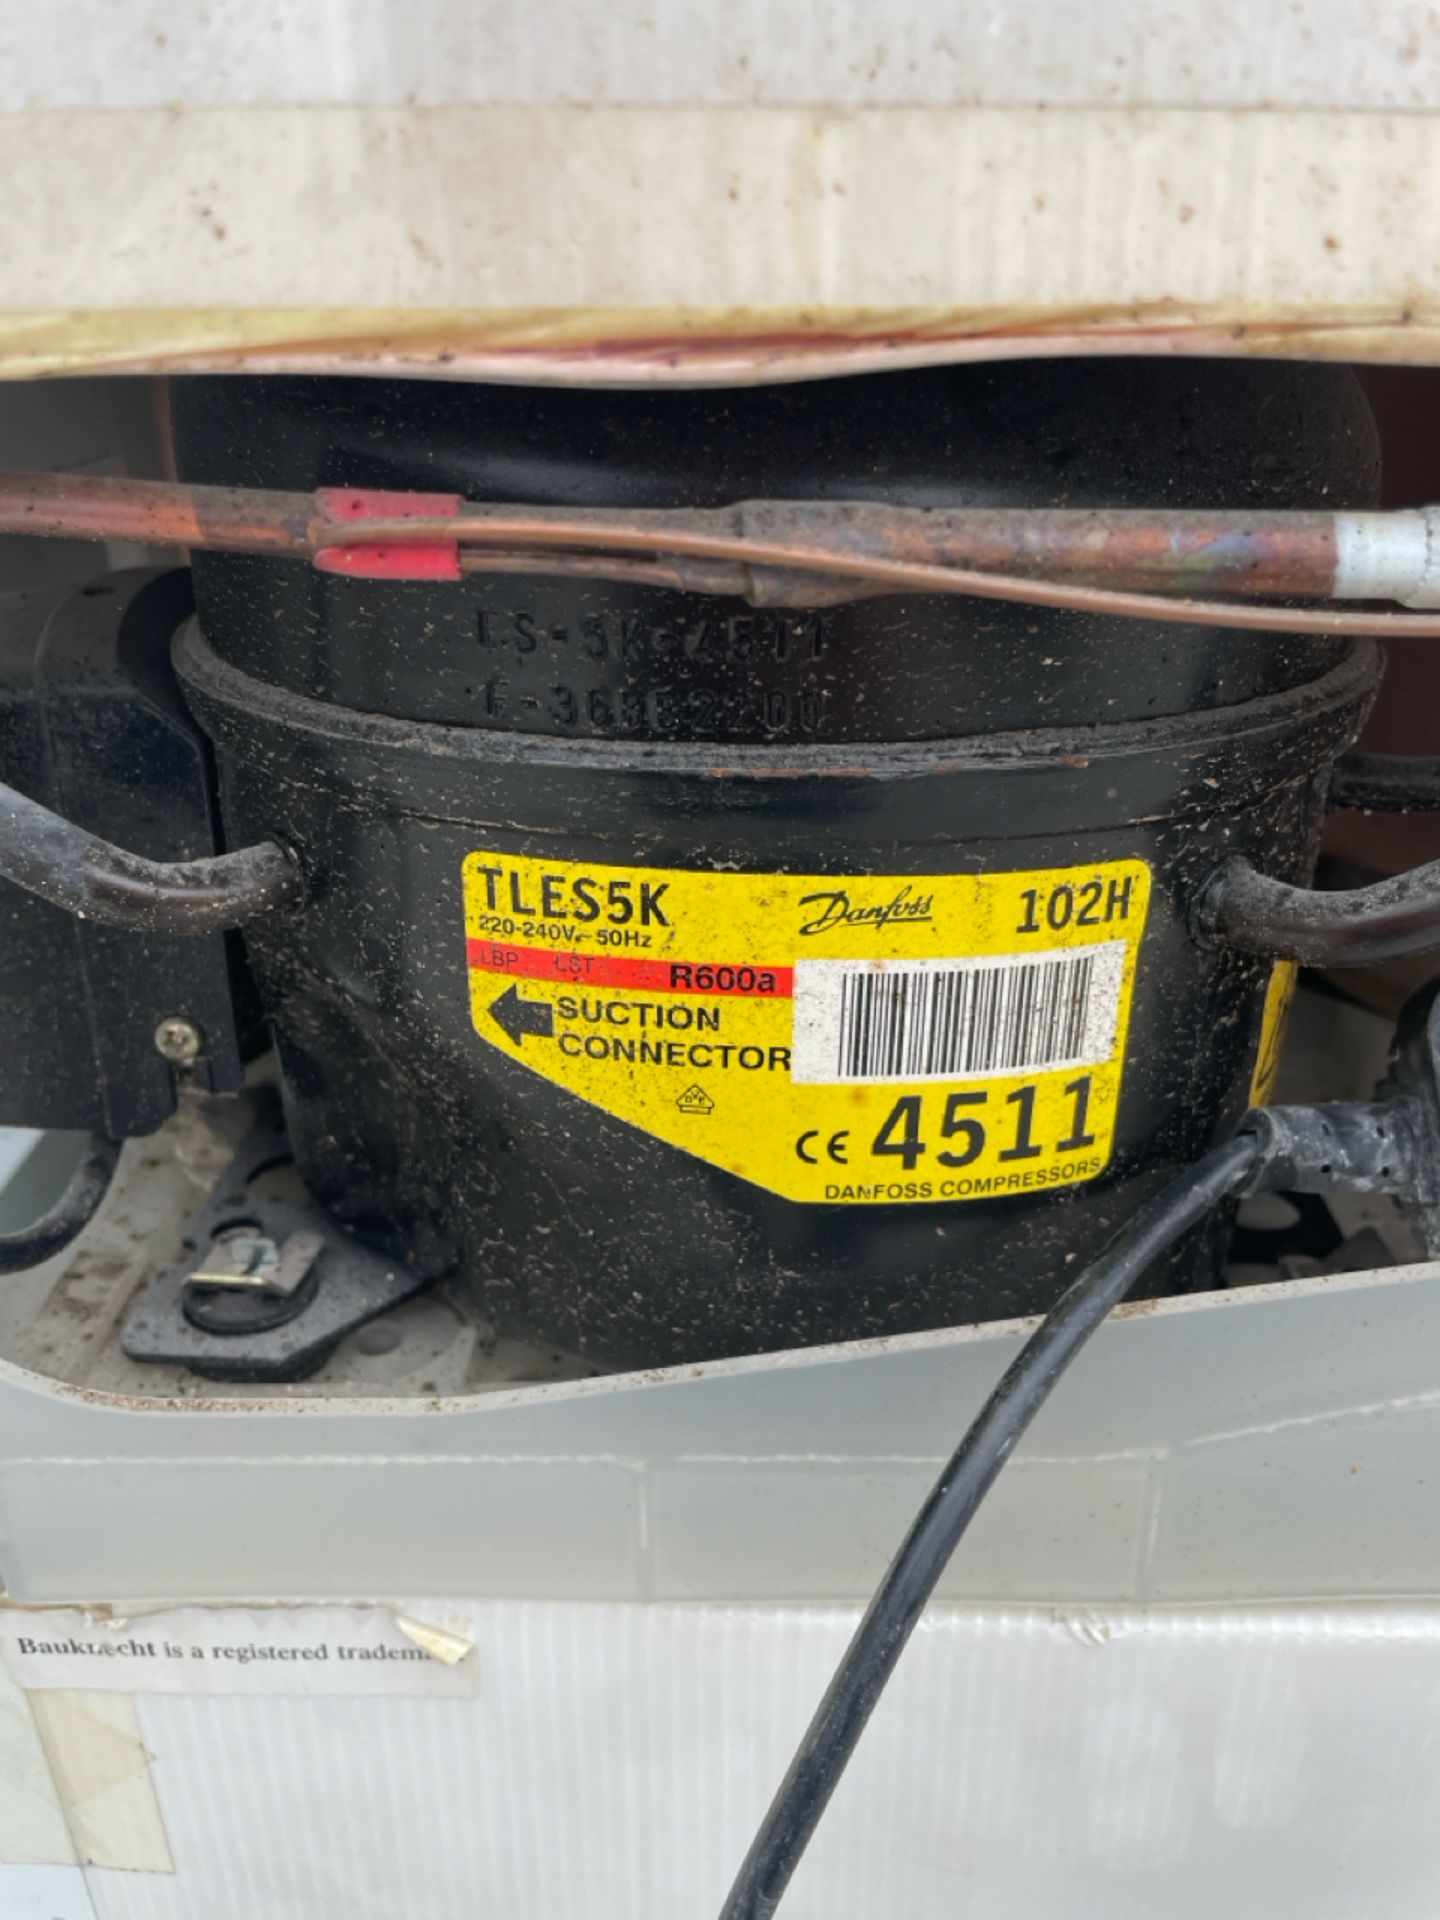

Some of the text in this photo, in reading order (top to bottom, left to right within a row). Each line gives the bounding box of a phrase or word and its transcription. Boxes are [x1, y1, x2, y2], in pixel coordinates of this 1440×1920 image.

[478, 866, 671, 927] TLES5K
[799, 885, 933, 935] Danfoss
[1016, 875, 1133, 934] 102H
[596, 929, 652, 948] 50Hz
[480, 949, 518, 967] LBP
[670, 964, 776, 993] R600a
[557, 996, 720, 1031] SUCTION
[558, 1033, 792, 1071] CONNECTOR
[870, 1074, 1097, 1170] 4511
[796, 1130, 850, 1164] CE
[825, 1157, 1101, 1201] DANFOSS COMPRESSORS
[164, 1642, 183, 1659] is
[191, 1645, 205, 1659] a
[212, 1644, 328, 1662] registered
